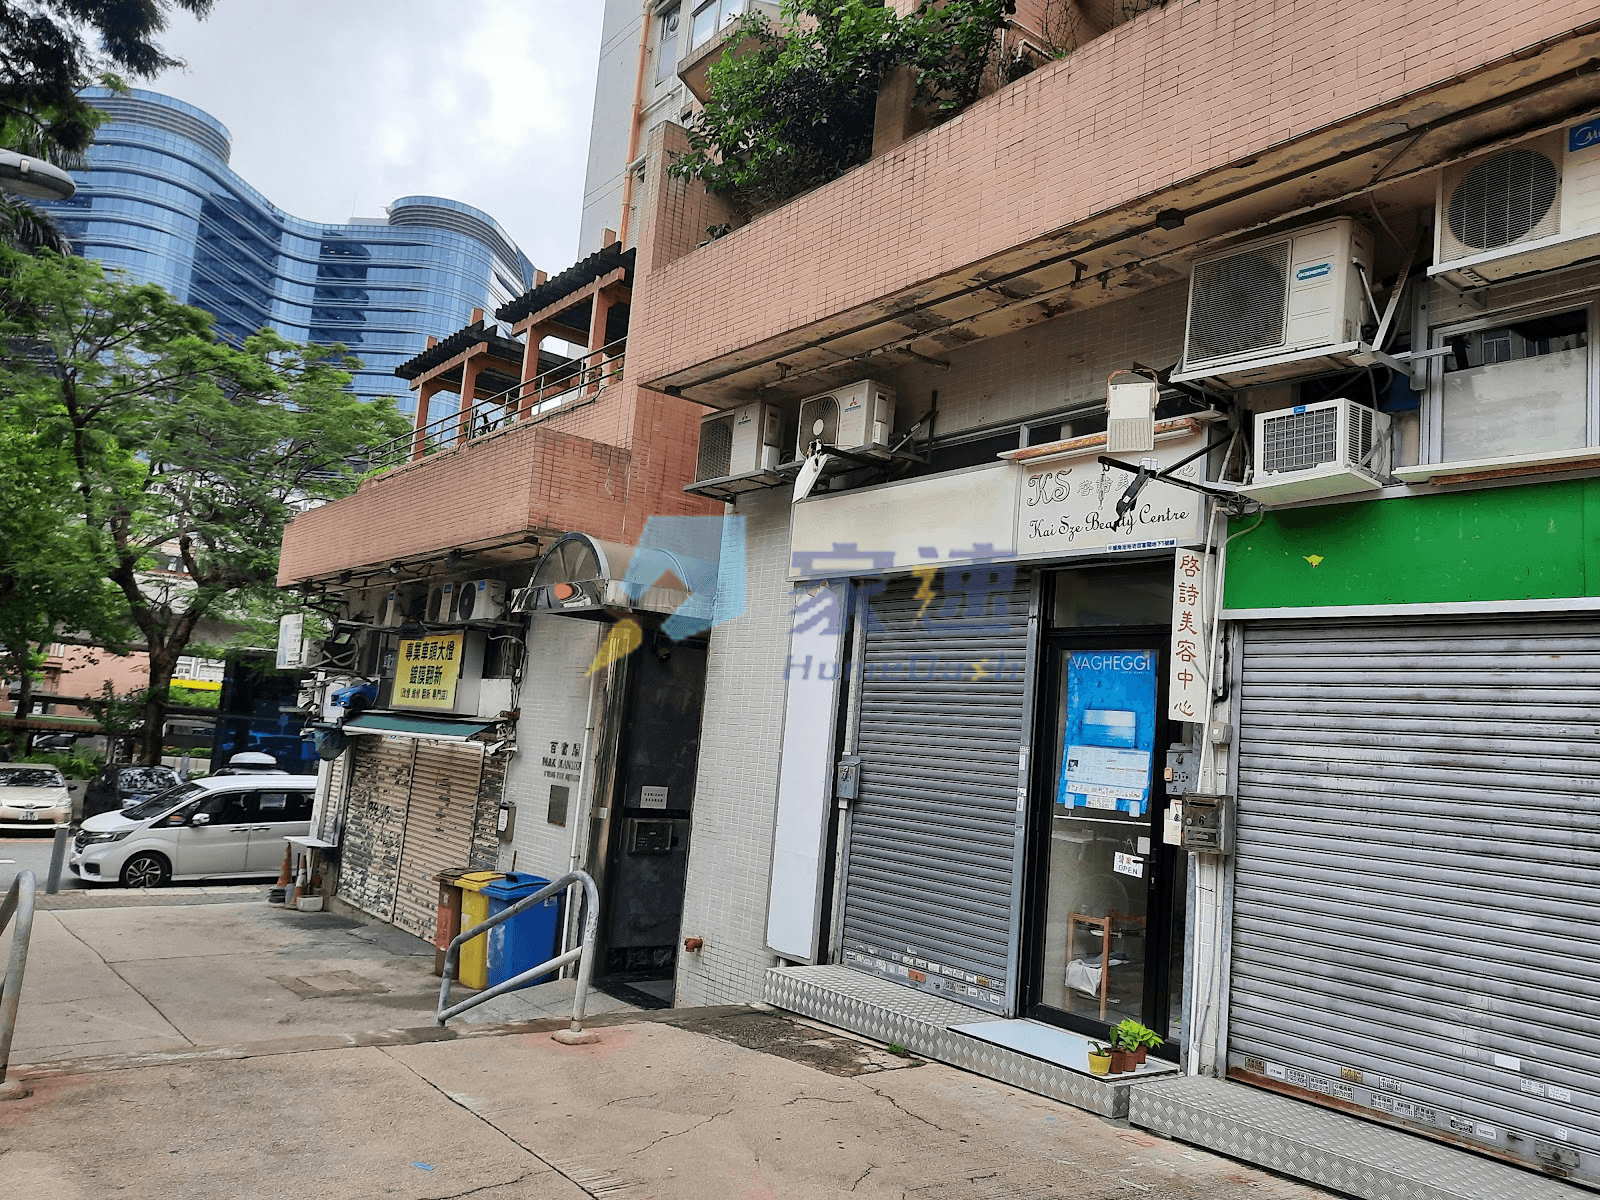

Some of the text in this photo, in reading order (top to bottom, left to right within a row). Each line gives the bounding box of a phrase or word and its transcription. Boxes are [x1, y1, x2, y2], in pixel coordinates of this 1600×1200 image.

[1027, 468, 1073, 507] KS
[1029, 519, 1057, 539] Kai
[1058, 515, 1083, 542] Sze
[1139, 503, 1189, 525] Centre
[405, 640, 455, 661] 專業車頭大燈
[1072, 655, 1150, 671] VAGHEGGI
[1198, 814, 1207, 827] 6
[1118, 864, 1138, 876] OPEN
